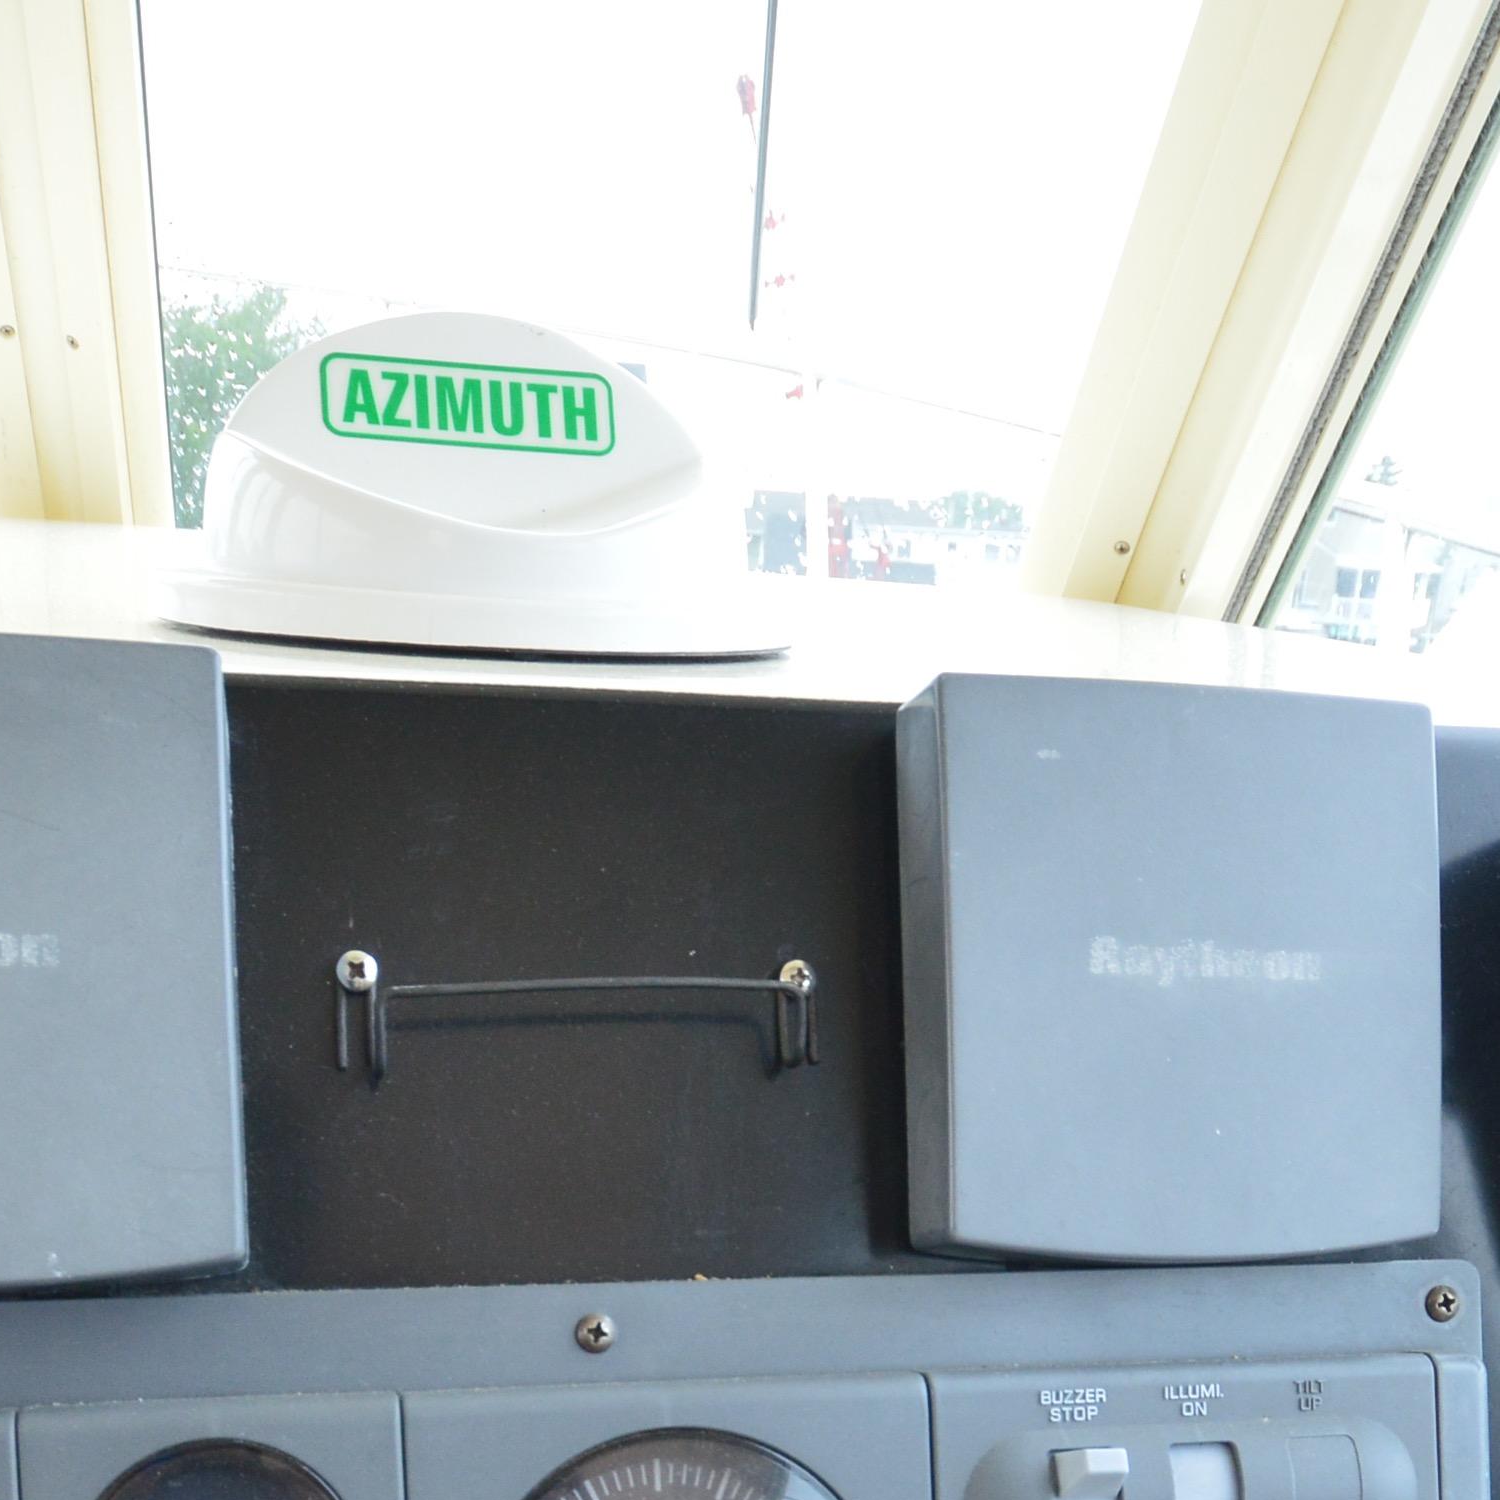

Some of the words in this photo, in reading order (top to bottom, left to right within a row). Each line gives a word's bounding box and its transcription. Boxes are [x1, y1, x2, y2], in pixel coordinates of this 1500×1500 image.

[343, 368, 598, 441] AZIMUTH
[1293, 1379, 1325, 1395] TILT
[1040, 1388, 1107, 1406] BUZZER
[1298, 1396, 1323, 1411] UP
[1049, 1405, 1098, 1422] STOP
[1181, 1401, 1208, 1417] ON
